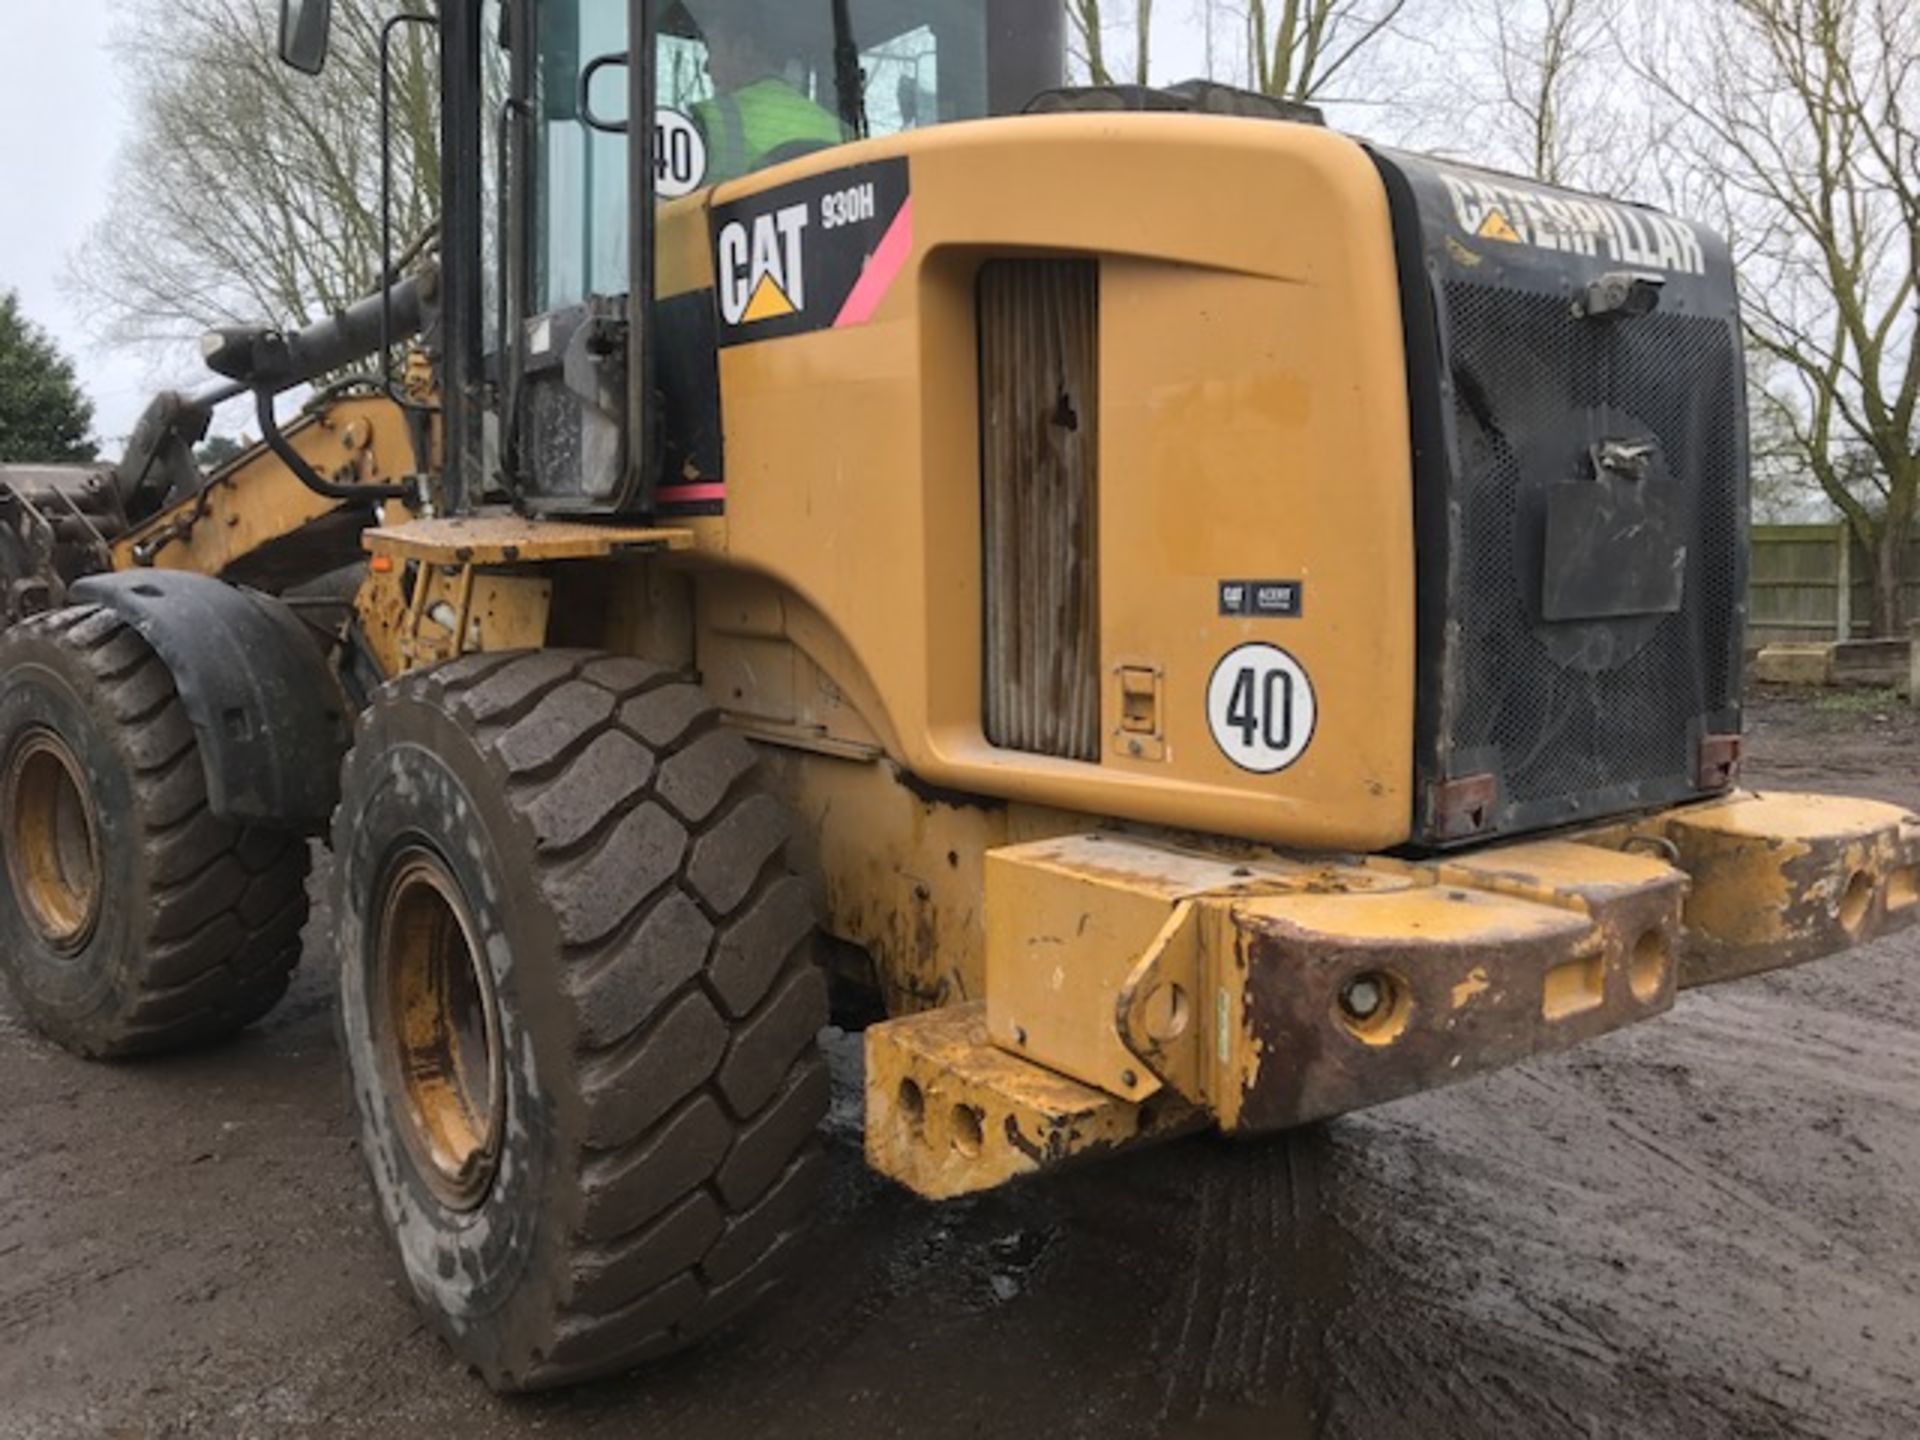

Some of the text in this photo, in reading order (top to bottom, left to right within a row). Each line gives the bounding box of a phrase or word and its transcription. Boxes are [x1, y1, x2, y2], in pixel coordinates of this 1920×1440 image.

[719, 183, 874, 325] CAT 930H
[1440, 173, 1705, 275] CATERPILLAR
[1226, 667, 1293, 751] 40
